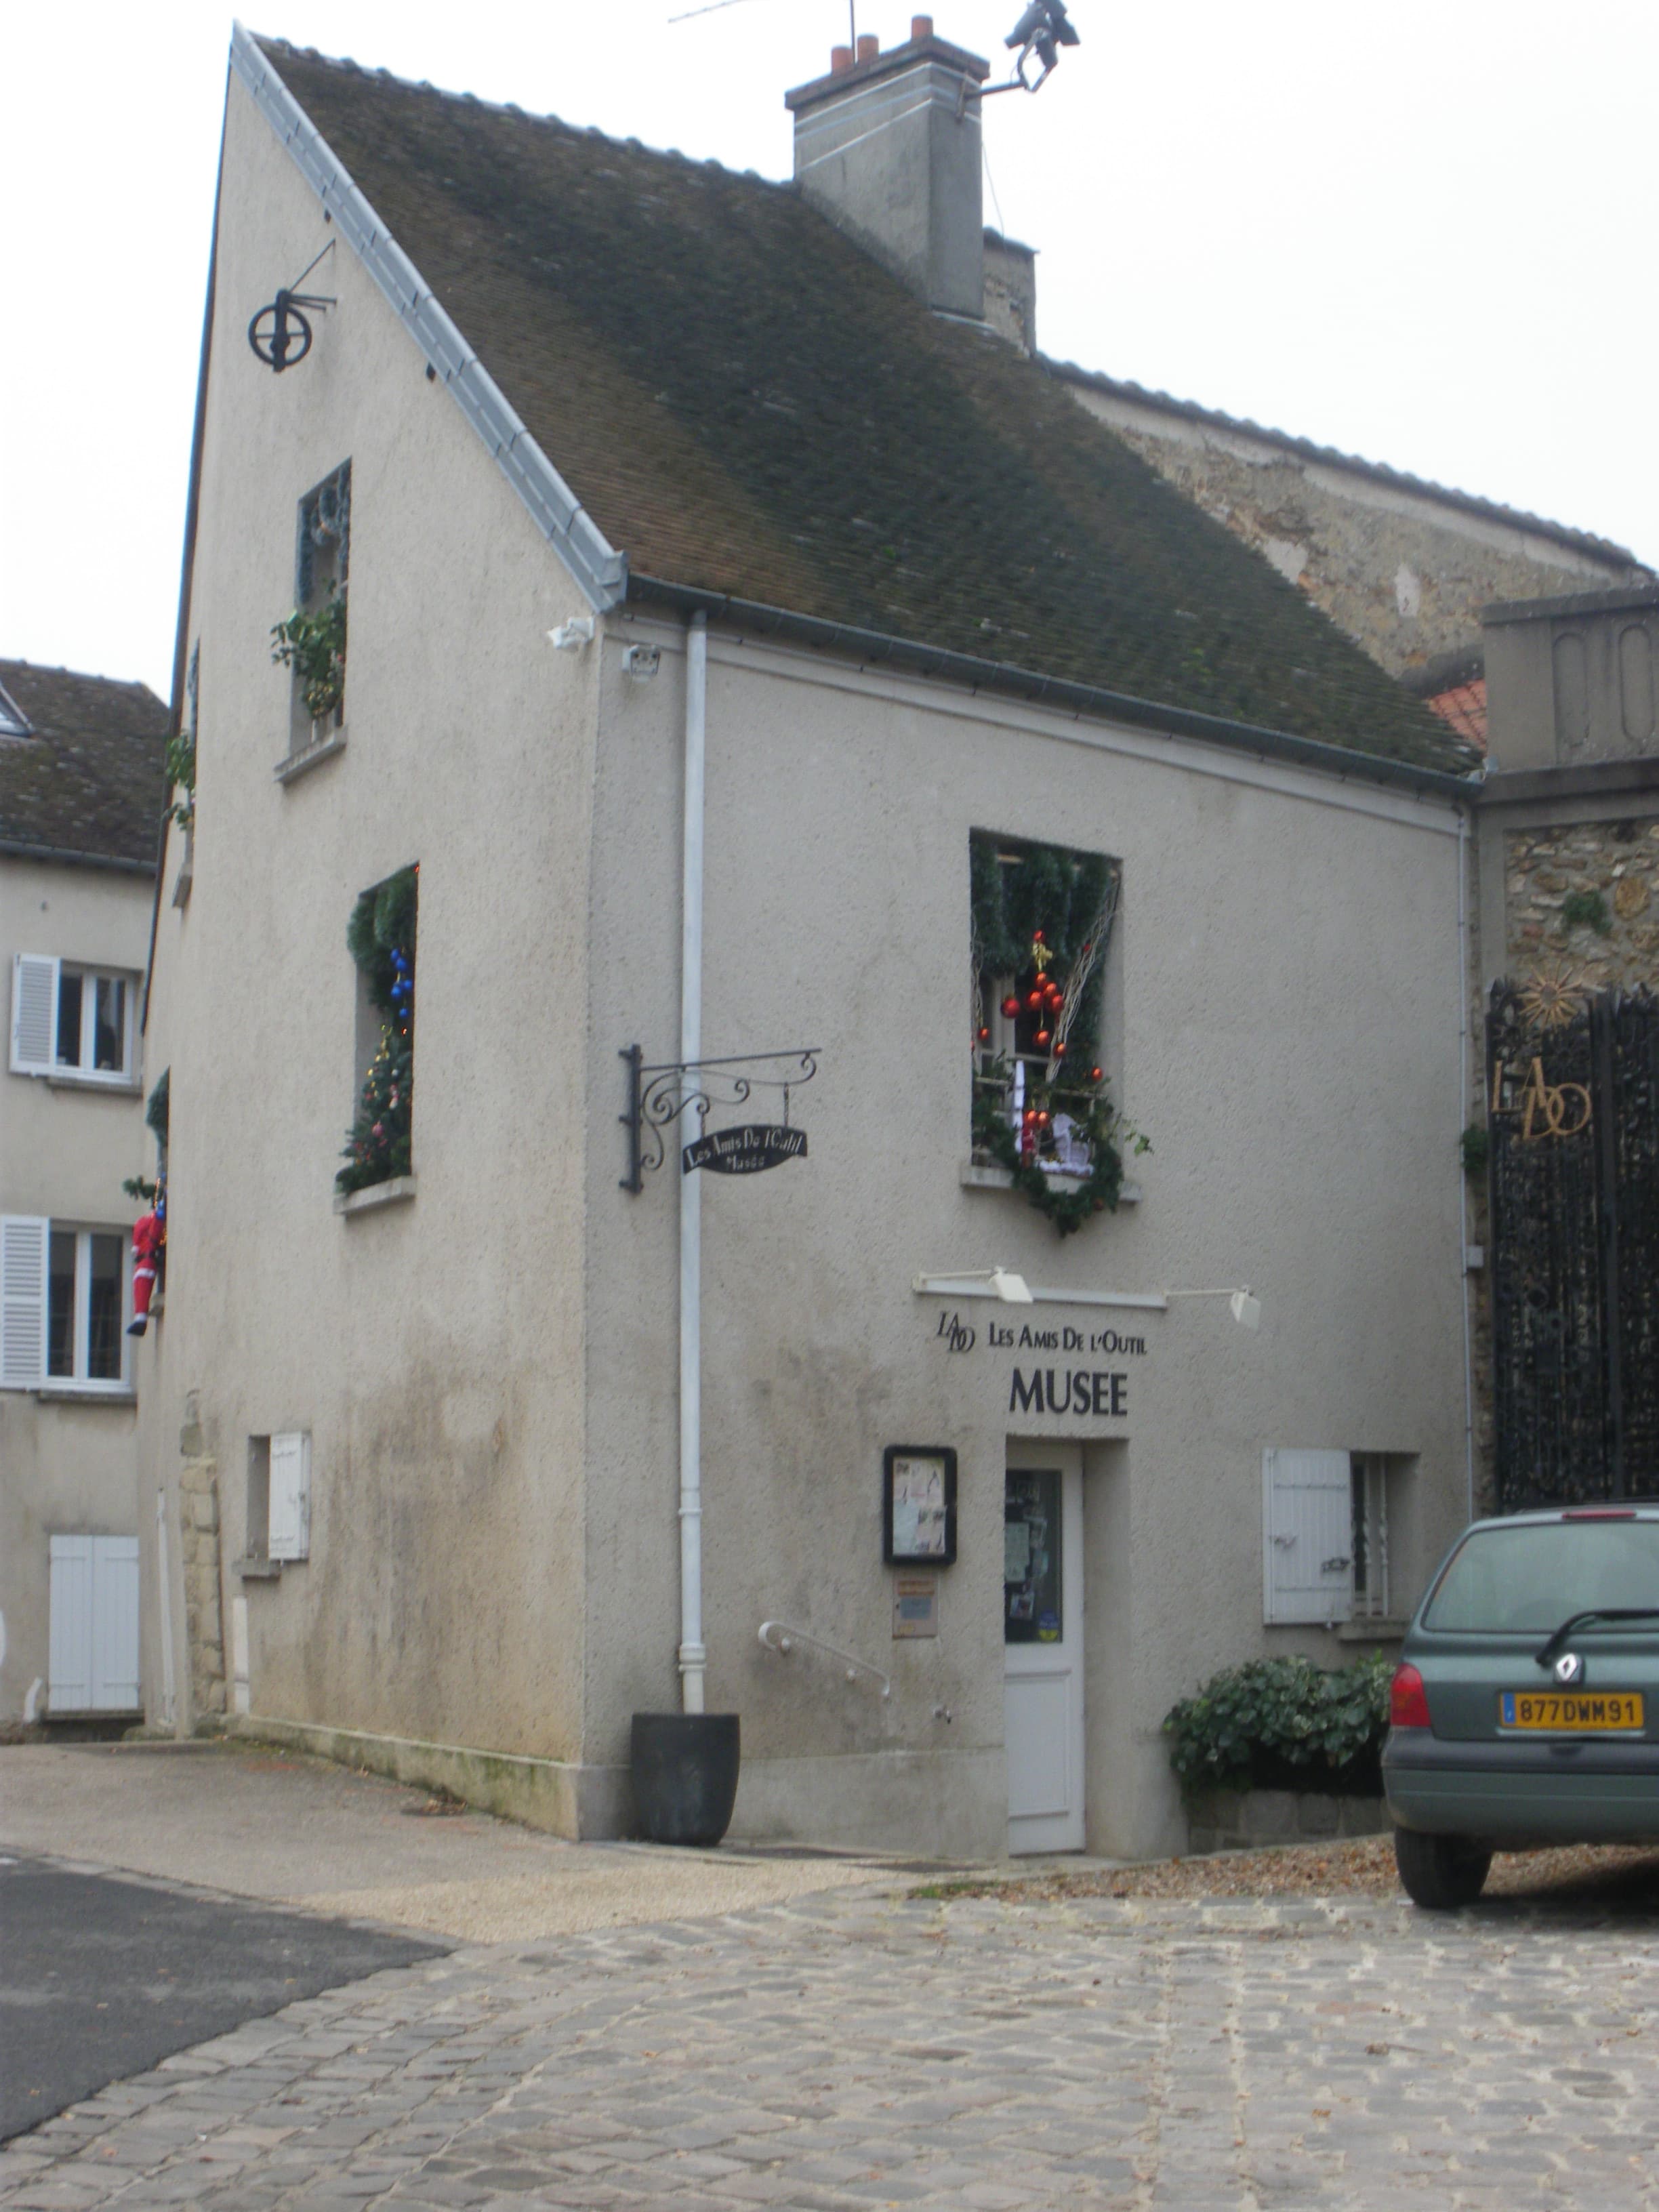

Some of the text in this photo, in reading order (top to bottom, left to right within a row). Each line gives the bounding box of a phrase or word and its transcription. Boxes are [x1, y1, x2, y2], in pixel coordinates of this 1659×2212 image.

[687, 1148, 711, 1168] Les
[713, 1134, 742, 1155] Amis
[1008, 1366, 1128, 1417] MUSEE
